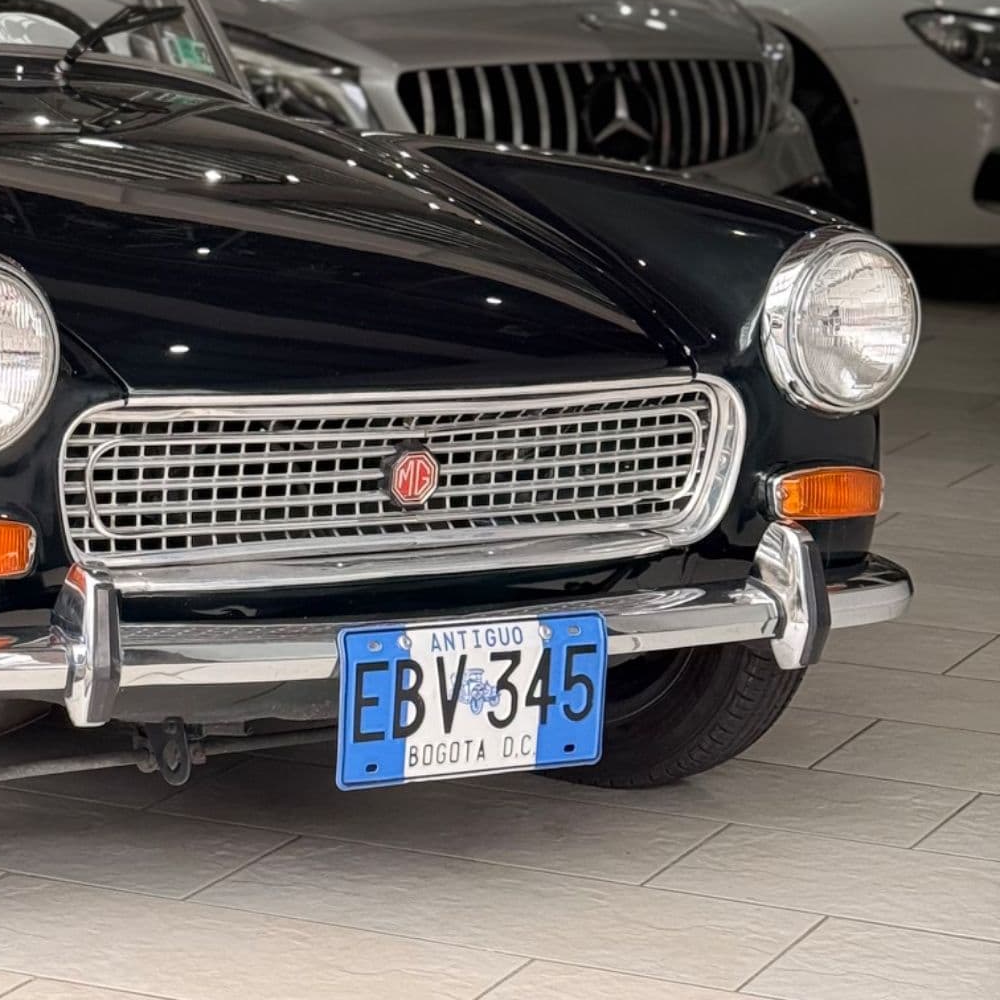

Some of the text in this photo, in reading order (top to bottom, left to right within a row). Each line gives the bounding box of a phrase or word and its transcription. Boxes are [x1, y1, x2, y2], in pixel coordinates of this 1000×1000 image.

[398, 458, 431, 497] MG
[430, 626, 524, 653] ANTIGUO
[408, 739, 486, 768] BOGOTA
